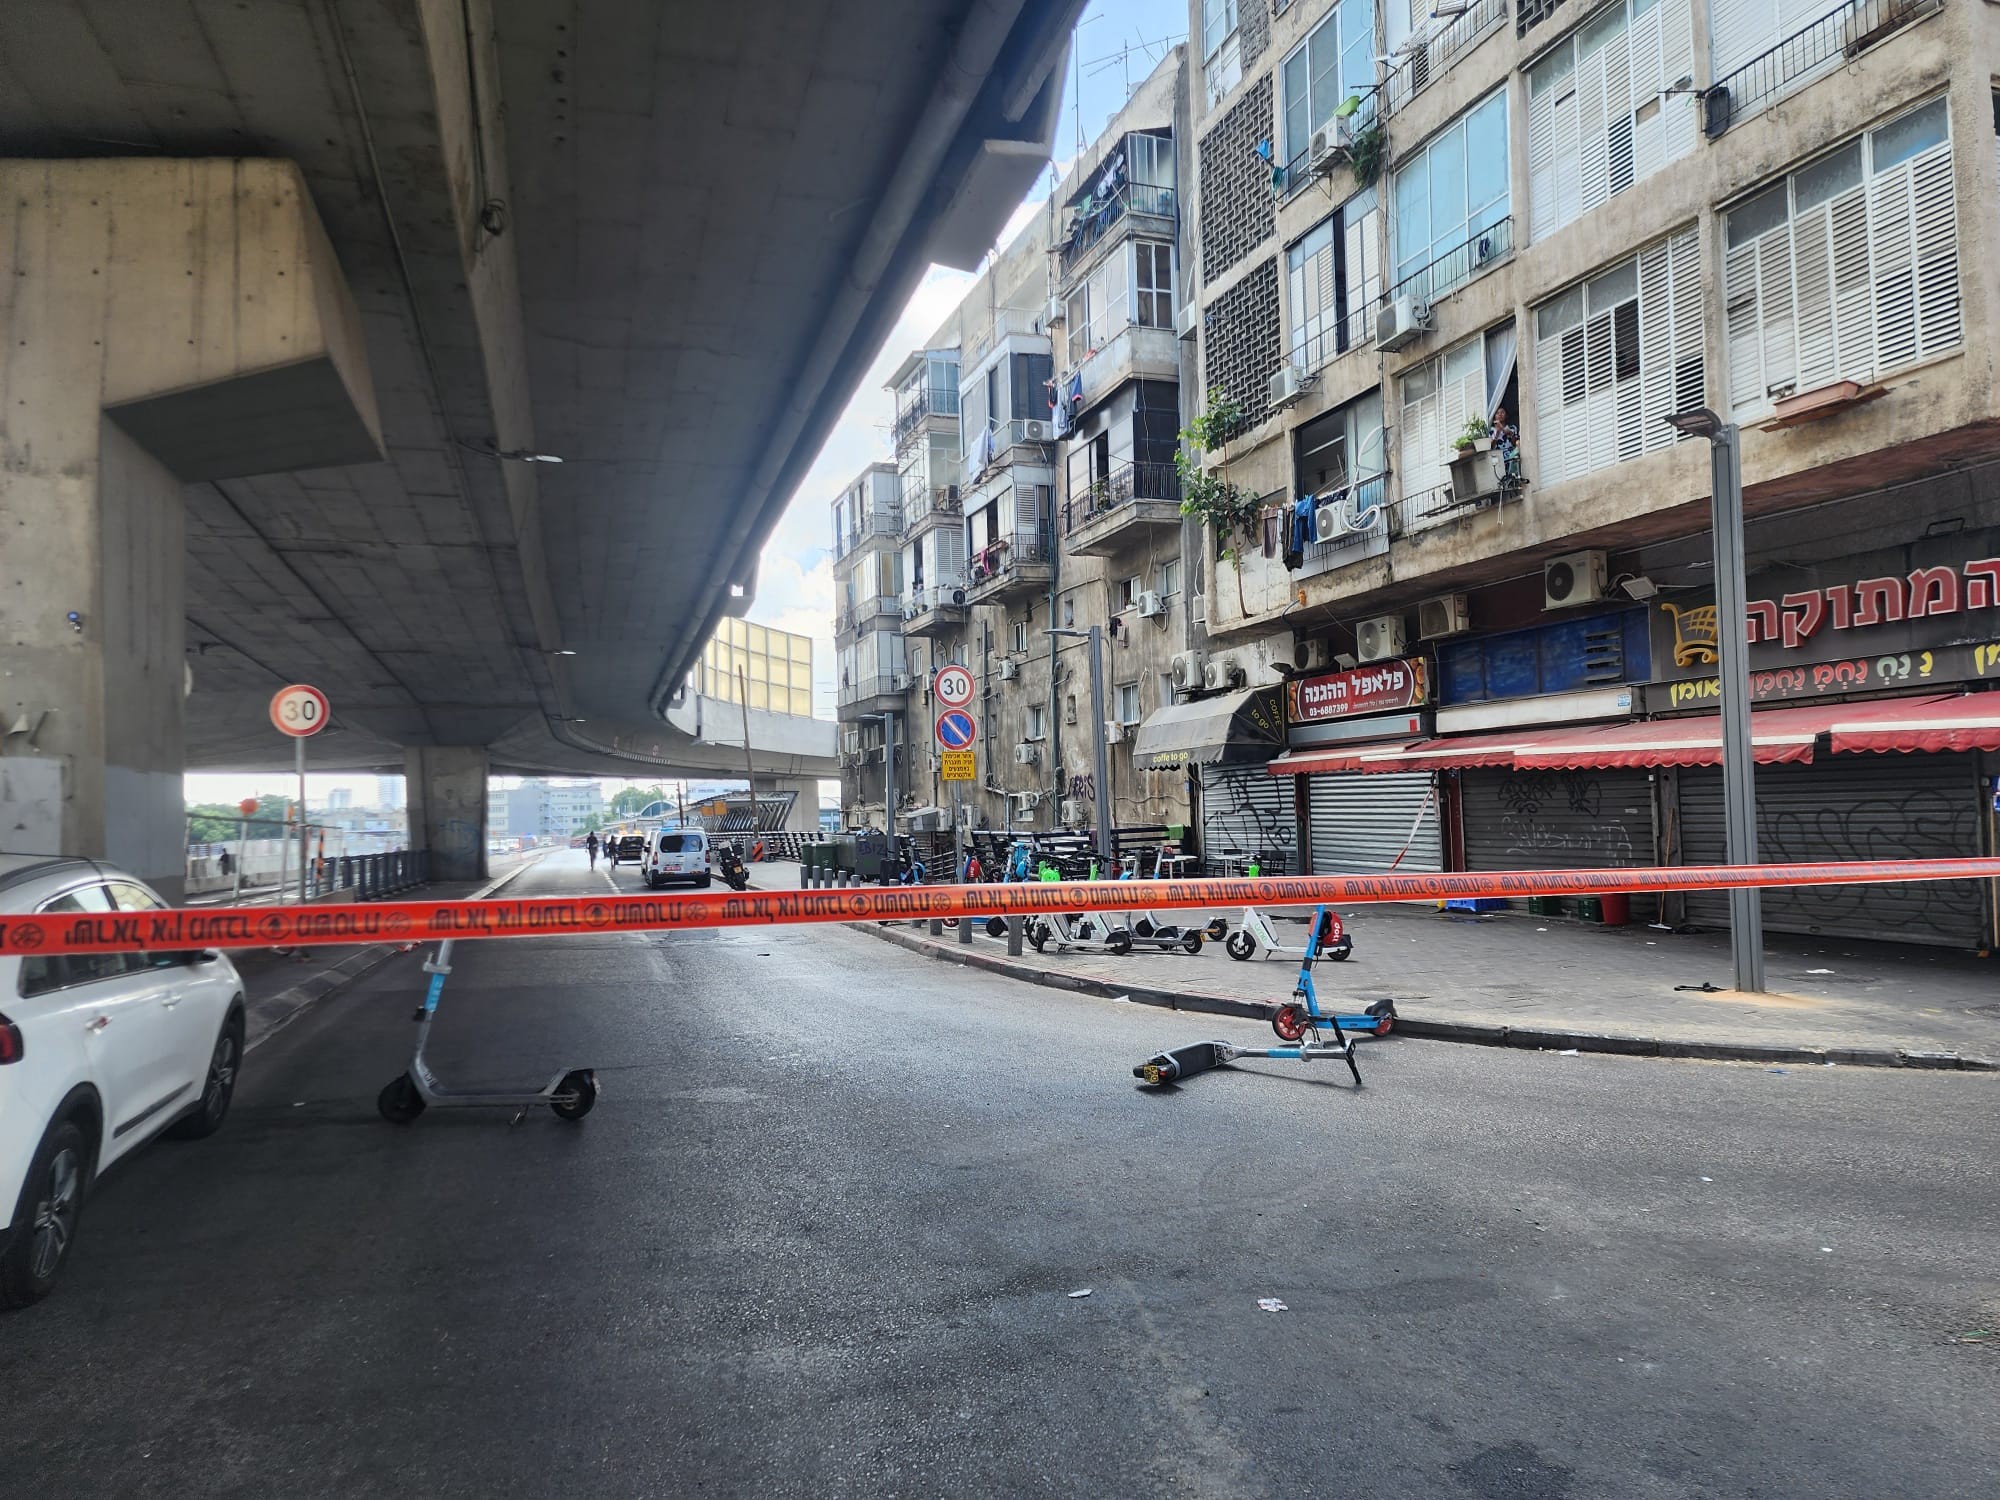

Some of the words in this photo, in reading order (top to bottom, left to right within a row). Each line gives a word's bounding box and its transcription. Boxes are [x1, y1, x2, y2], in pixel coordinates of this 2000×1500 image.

[1747, 557, 2000, 649] המתוקה
[944, 678, 967, 696] 30
[1304, 681, 1347, 704] ההגנה
[1351, 669, 1404, 696] פלאפל
[1670, 678, 1720, 708] אומן
[285, 700, 315, 721] 30
[1251, 709, 1260, 719] to
[1258, 718, 1269, 729] go
[1179, 751, 1189, 761] go
[64, 917, 145, 949] ישראל
[151, 912, 183, 944] אין
[190, 914, 253, 943] מעבר
[297, 911, 382, 937] משטרת
[428, 905, 492, 933] ישראל
[497, 902, 522, 930] אין
[529, 903, 581, 927] מעבר
[615, 901, 683, 924] משטרת
[722, 896, 774, 922] ישראל
[778, 893, 799, 918] אין
[804, 894, 847, 915] מעבר
[874, 893, 931, 913] משטרת
[962, 889, 1007, 913] ישראל
[1010, 886, 1027, 908] אין
[1031, 887, 1068, 907] מעבר
[1090, 886, 1139, 905] משטרת
[1166, 883, 1206, 906] ישראל
[1208, 880, 1222, 902] אין
[1226, 882, 1259, 901] מעבר
[1276, 881, 1320, 900] משטרת
[1344, 879, 1379, 901] ישראל
[1381, 876, 1394, 896] אין
[1396, 878, 1426, 896] מעבר
[1441, 877, 1481, 893] משטרת
